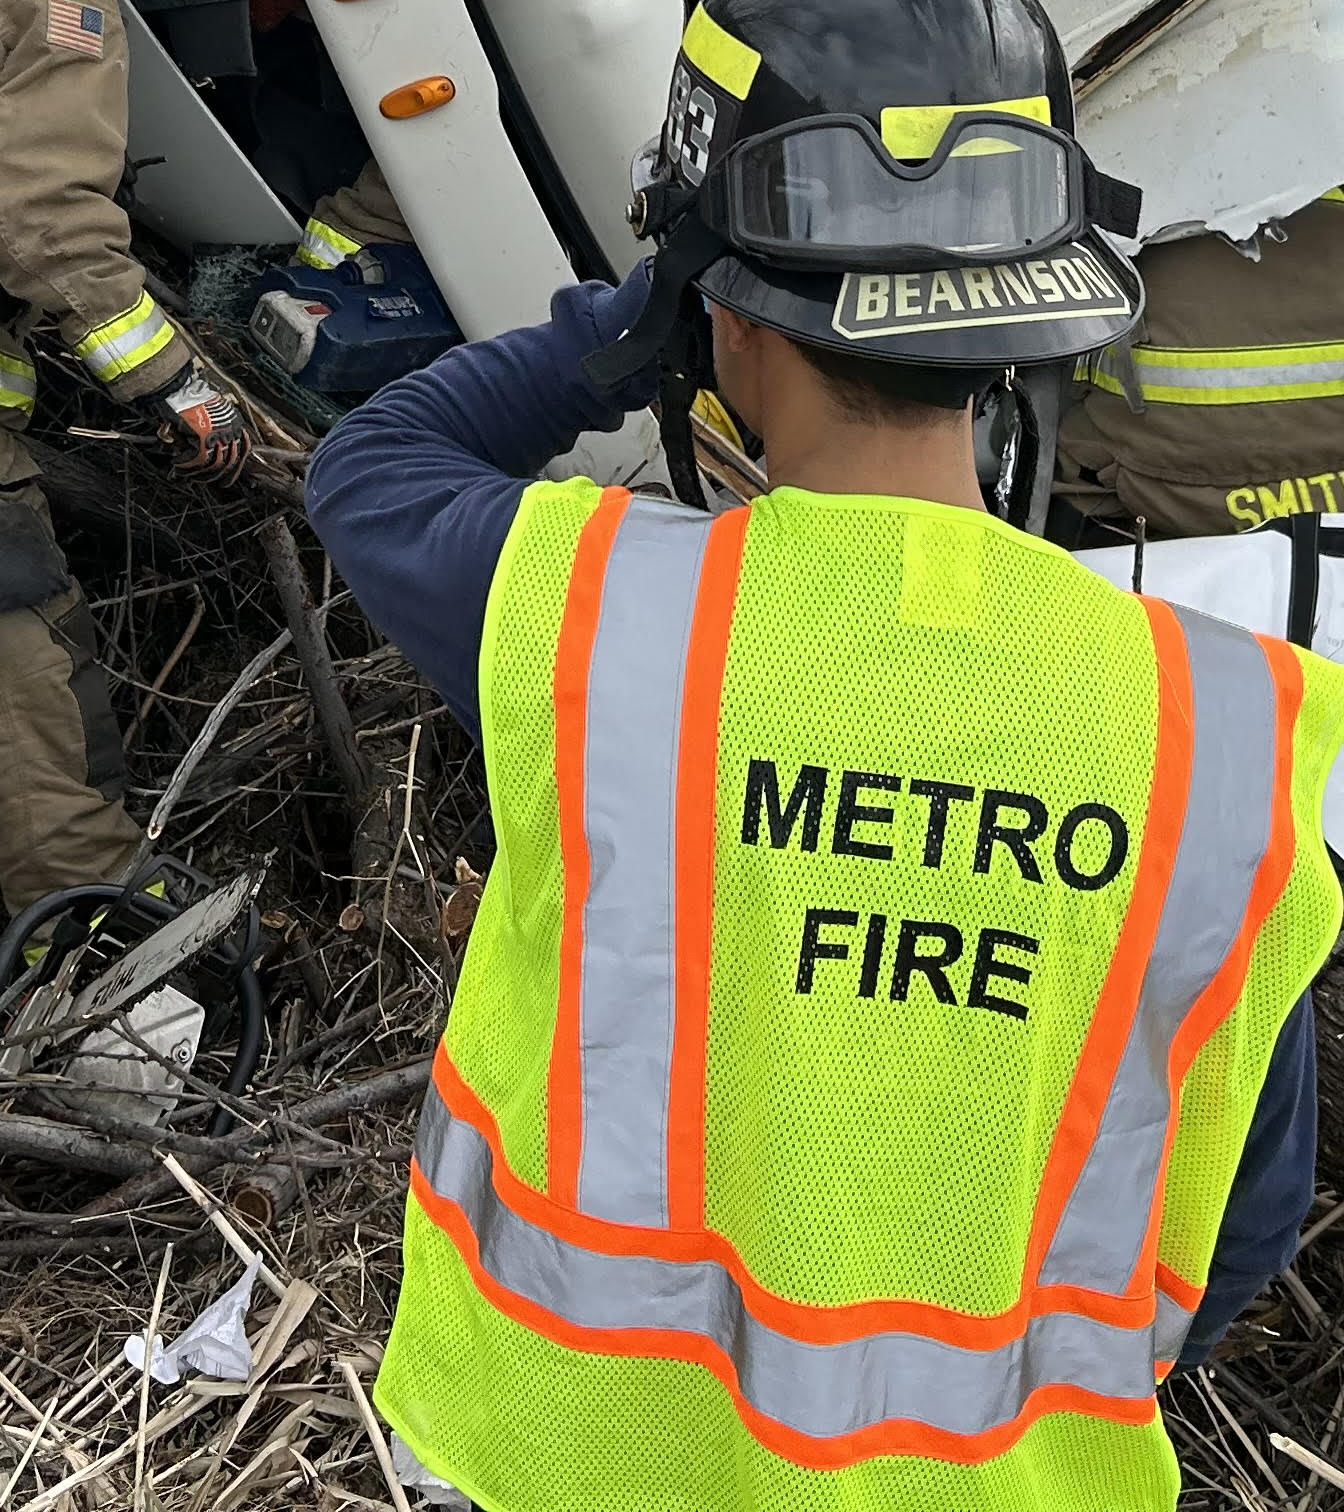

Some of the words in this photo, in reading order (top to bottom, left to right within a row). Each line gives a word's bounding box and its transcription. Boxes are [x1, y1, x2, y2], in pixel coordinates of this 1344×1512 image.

[667, 64, 717, 187] 83
[855, 256, 1116, 322] BEARNSON
[740, 756, 1130, 892] METRO
[794, 907, 1041, 1021] FIRE
